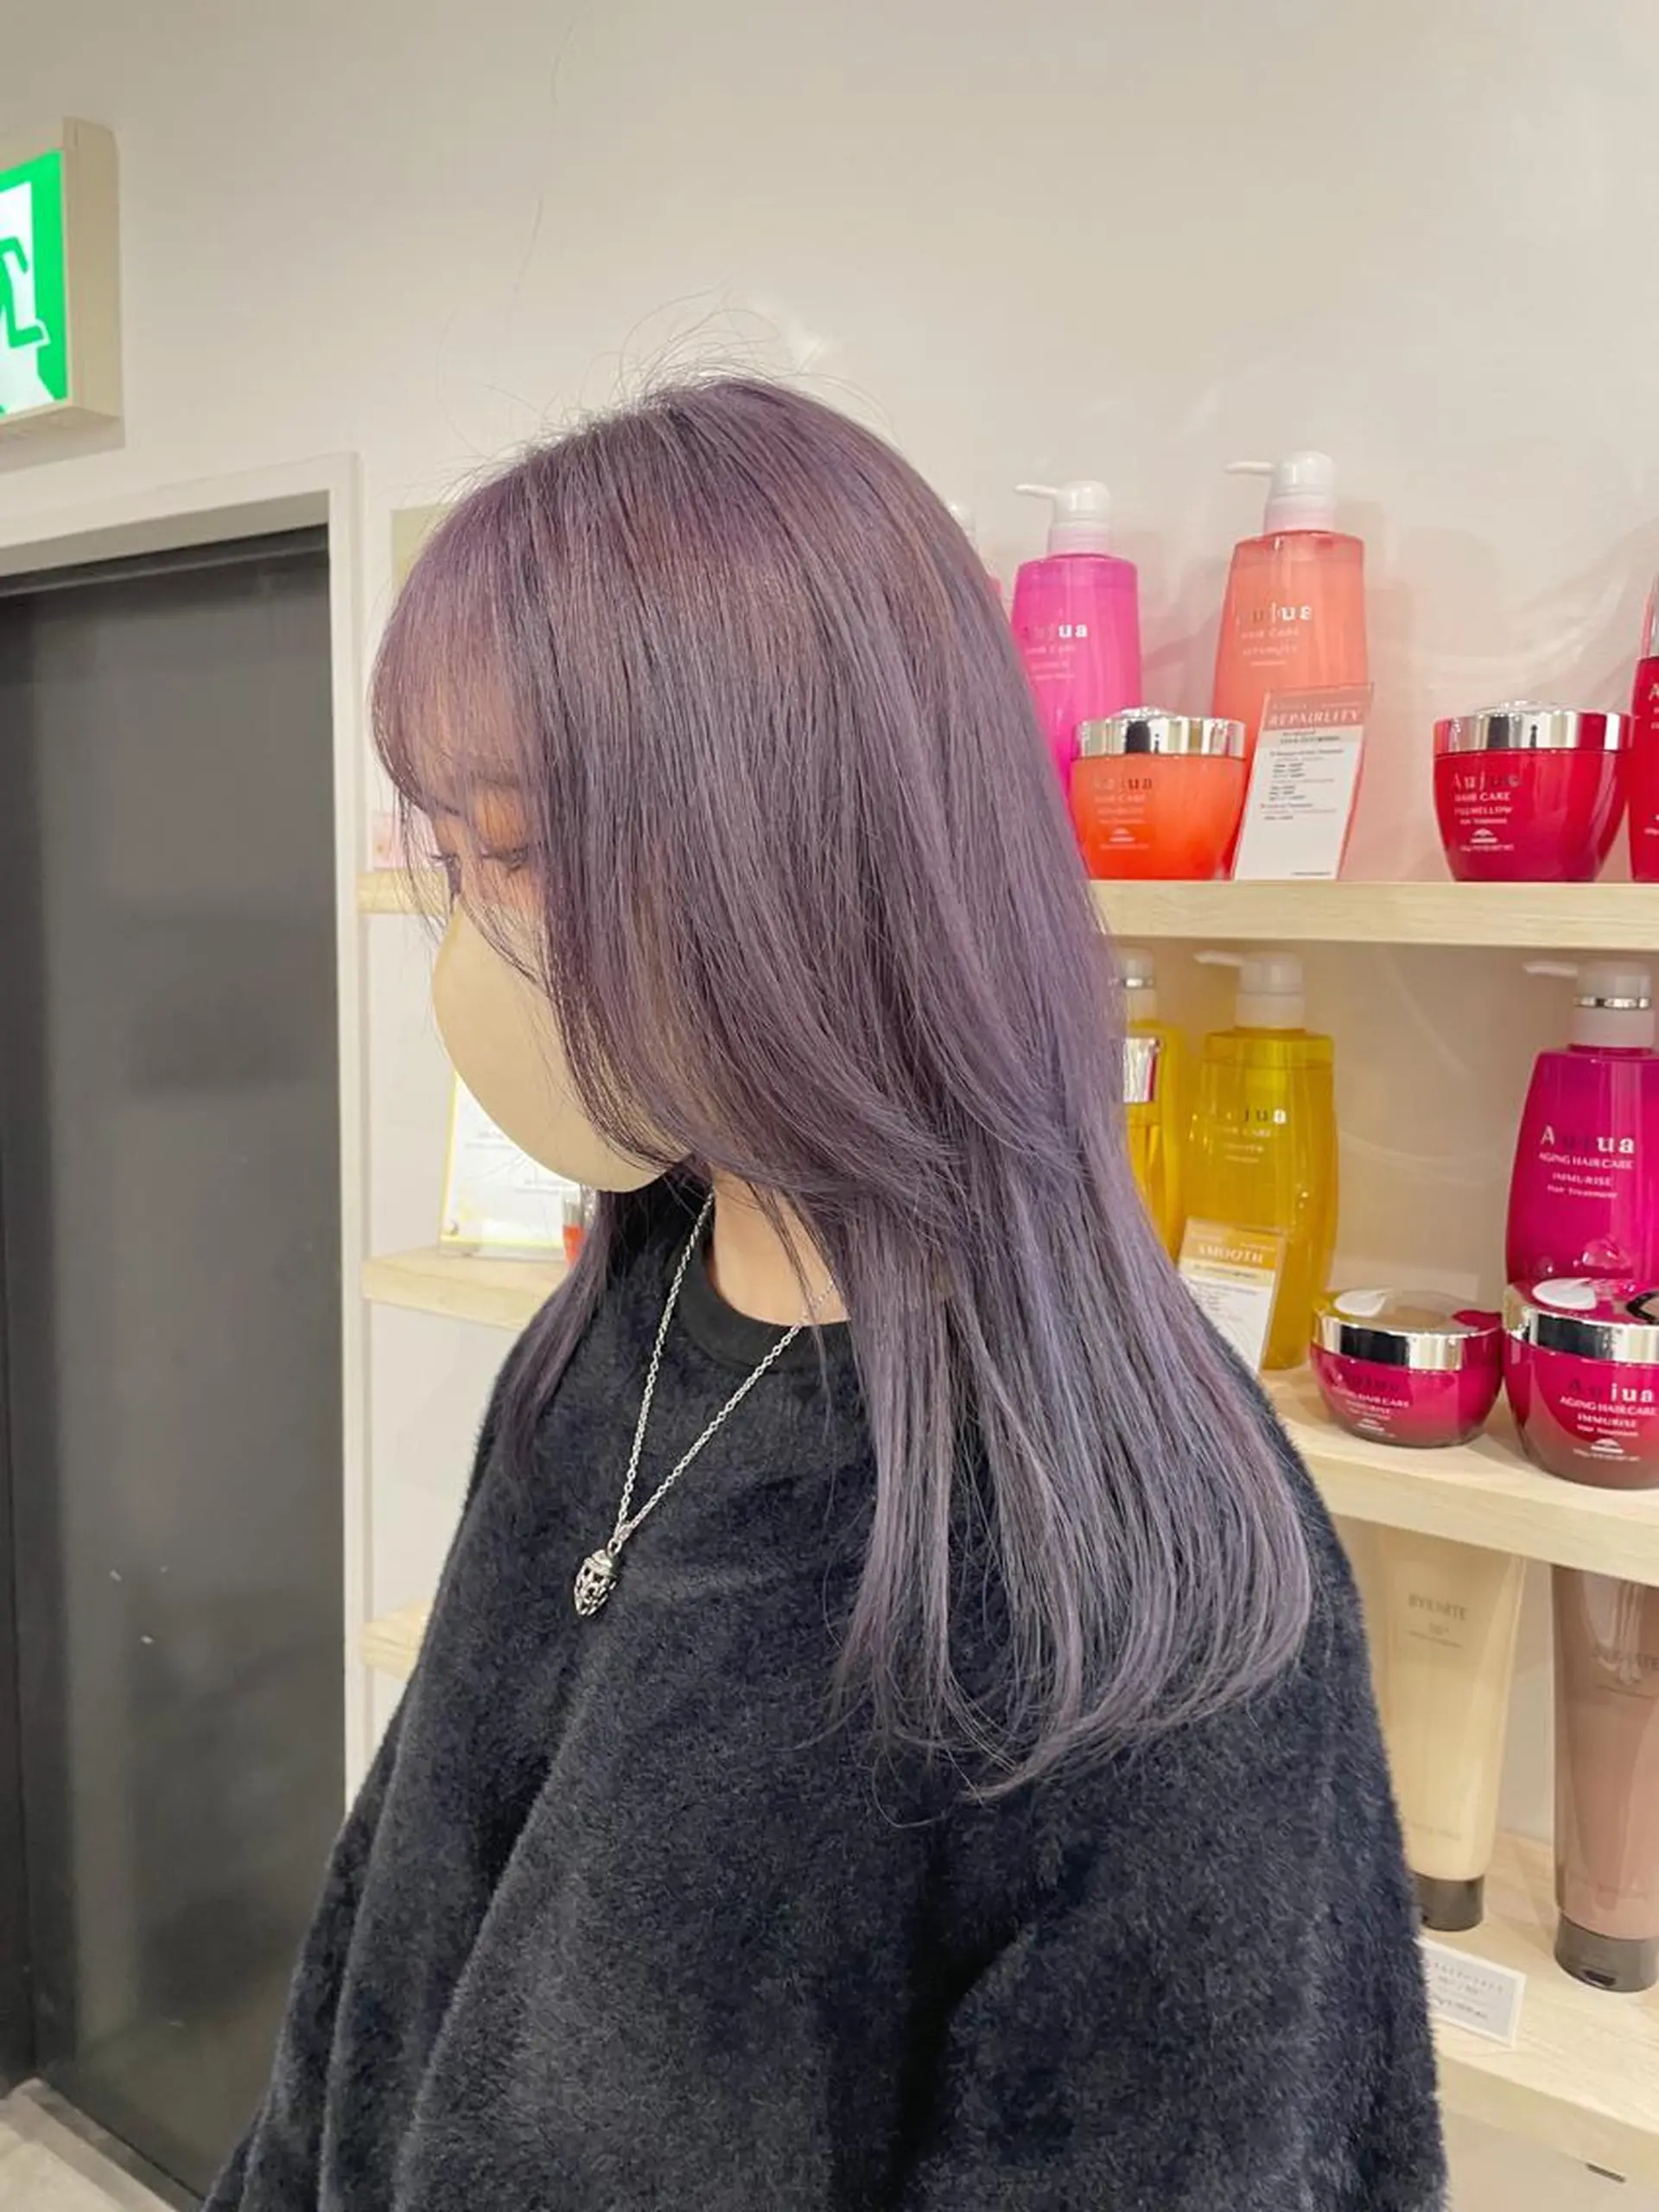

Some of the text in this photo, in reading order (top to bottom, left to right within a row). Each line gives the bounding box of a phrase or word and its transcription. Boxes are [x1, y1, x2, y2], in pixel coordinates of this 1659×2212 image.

[1478, 791, 1511, 802] CARE
[1572, 1155, 1600, 1168] HAIR
[1602, 1158, 1635, 1170] CARE
[1560, 1395, 1597, 1411] AGING
